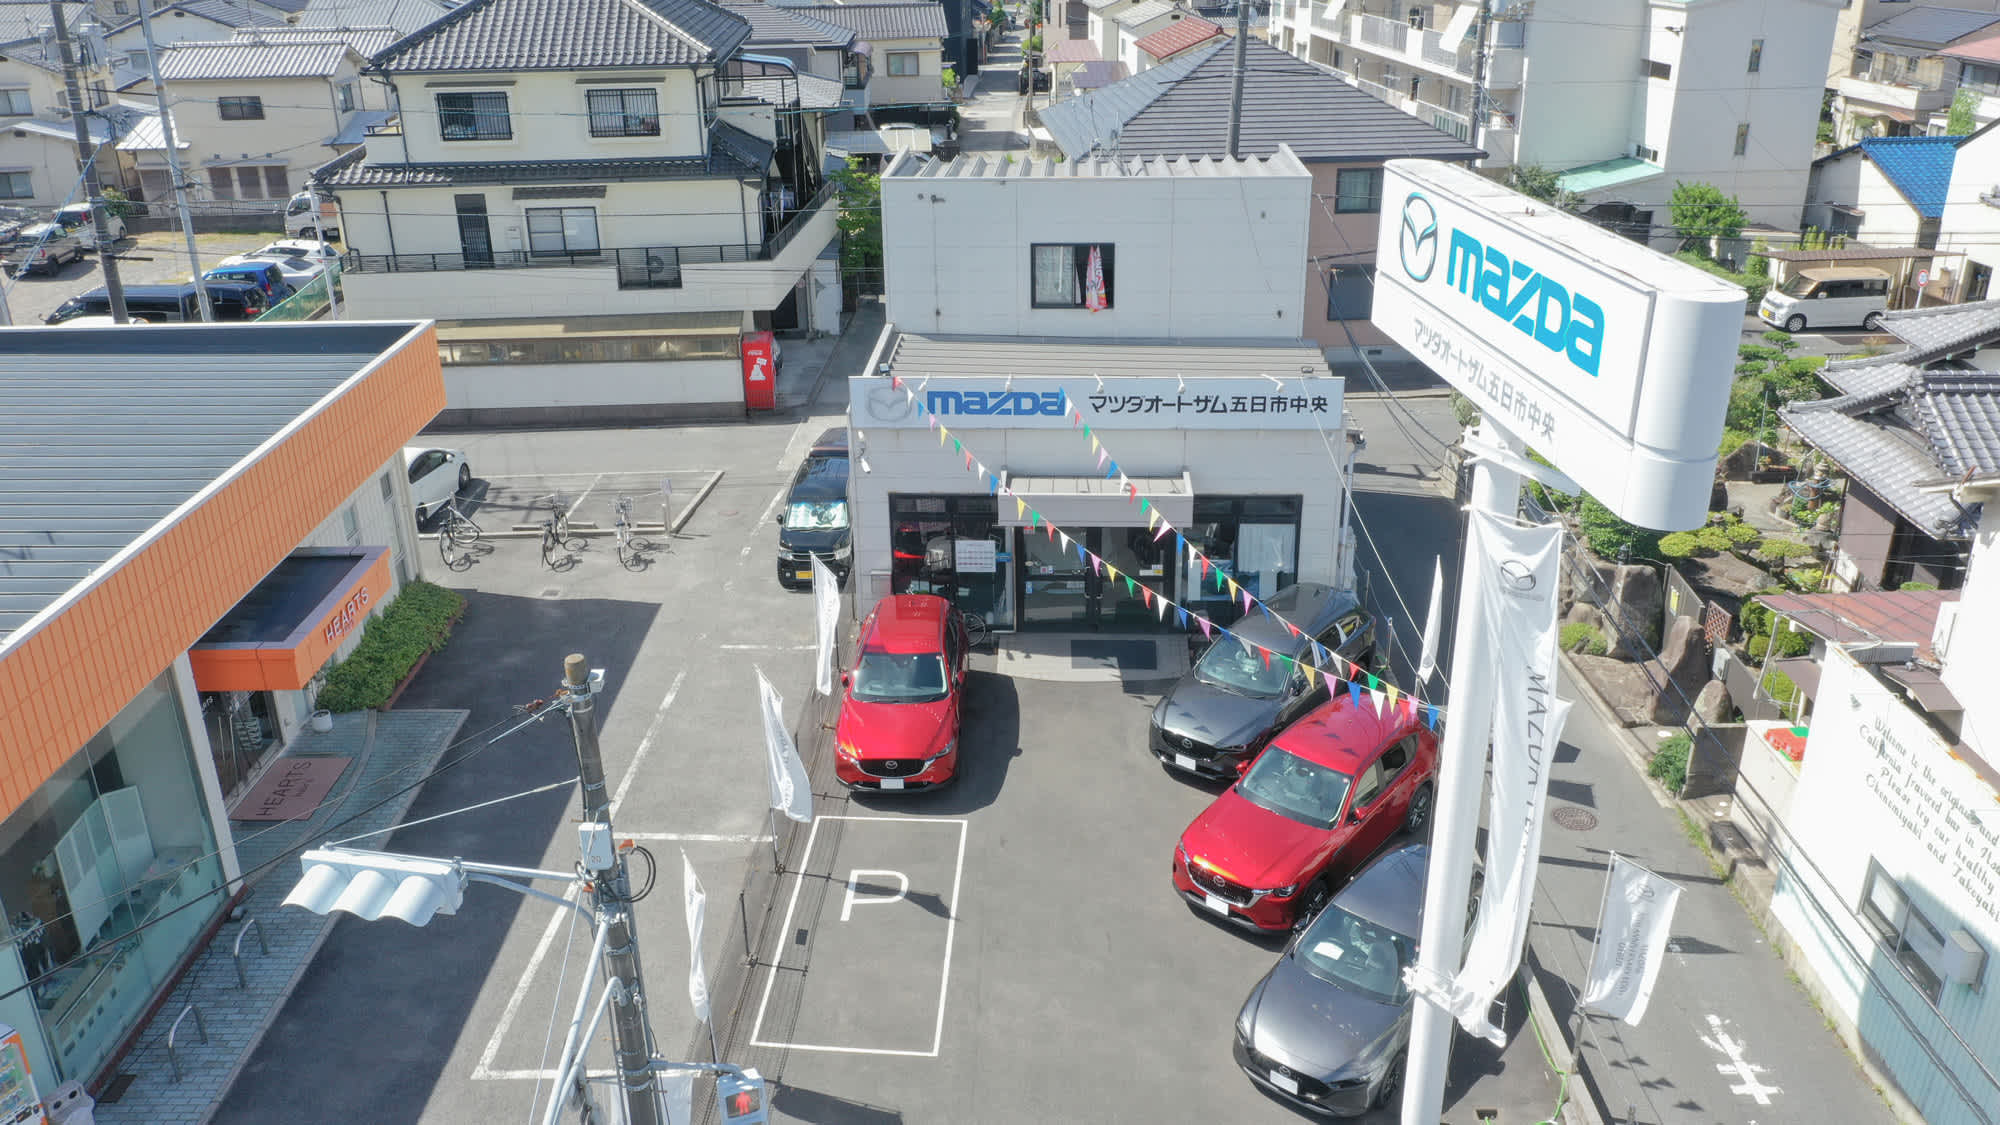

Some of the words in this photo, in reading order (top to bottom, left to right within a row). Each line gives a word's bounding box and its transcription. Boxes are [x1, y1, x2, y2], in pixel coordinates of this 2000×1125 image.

[1088, 395, 1329, 414] マツダオートザム五日市中央
[1414, 316, 1556, 446] マツダオートザム五日市中央
[325, 586, 369, 644] HEARTS
[256, 761, 312, 816] HEARTS
[840, 869, 909, 922] P
